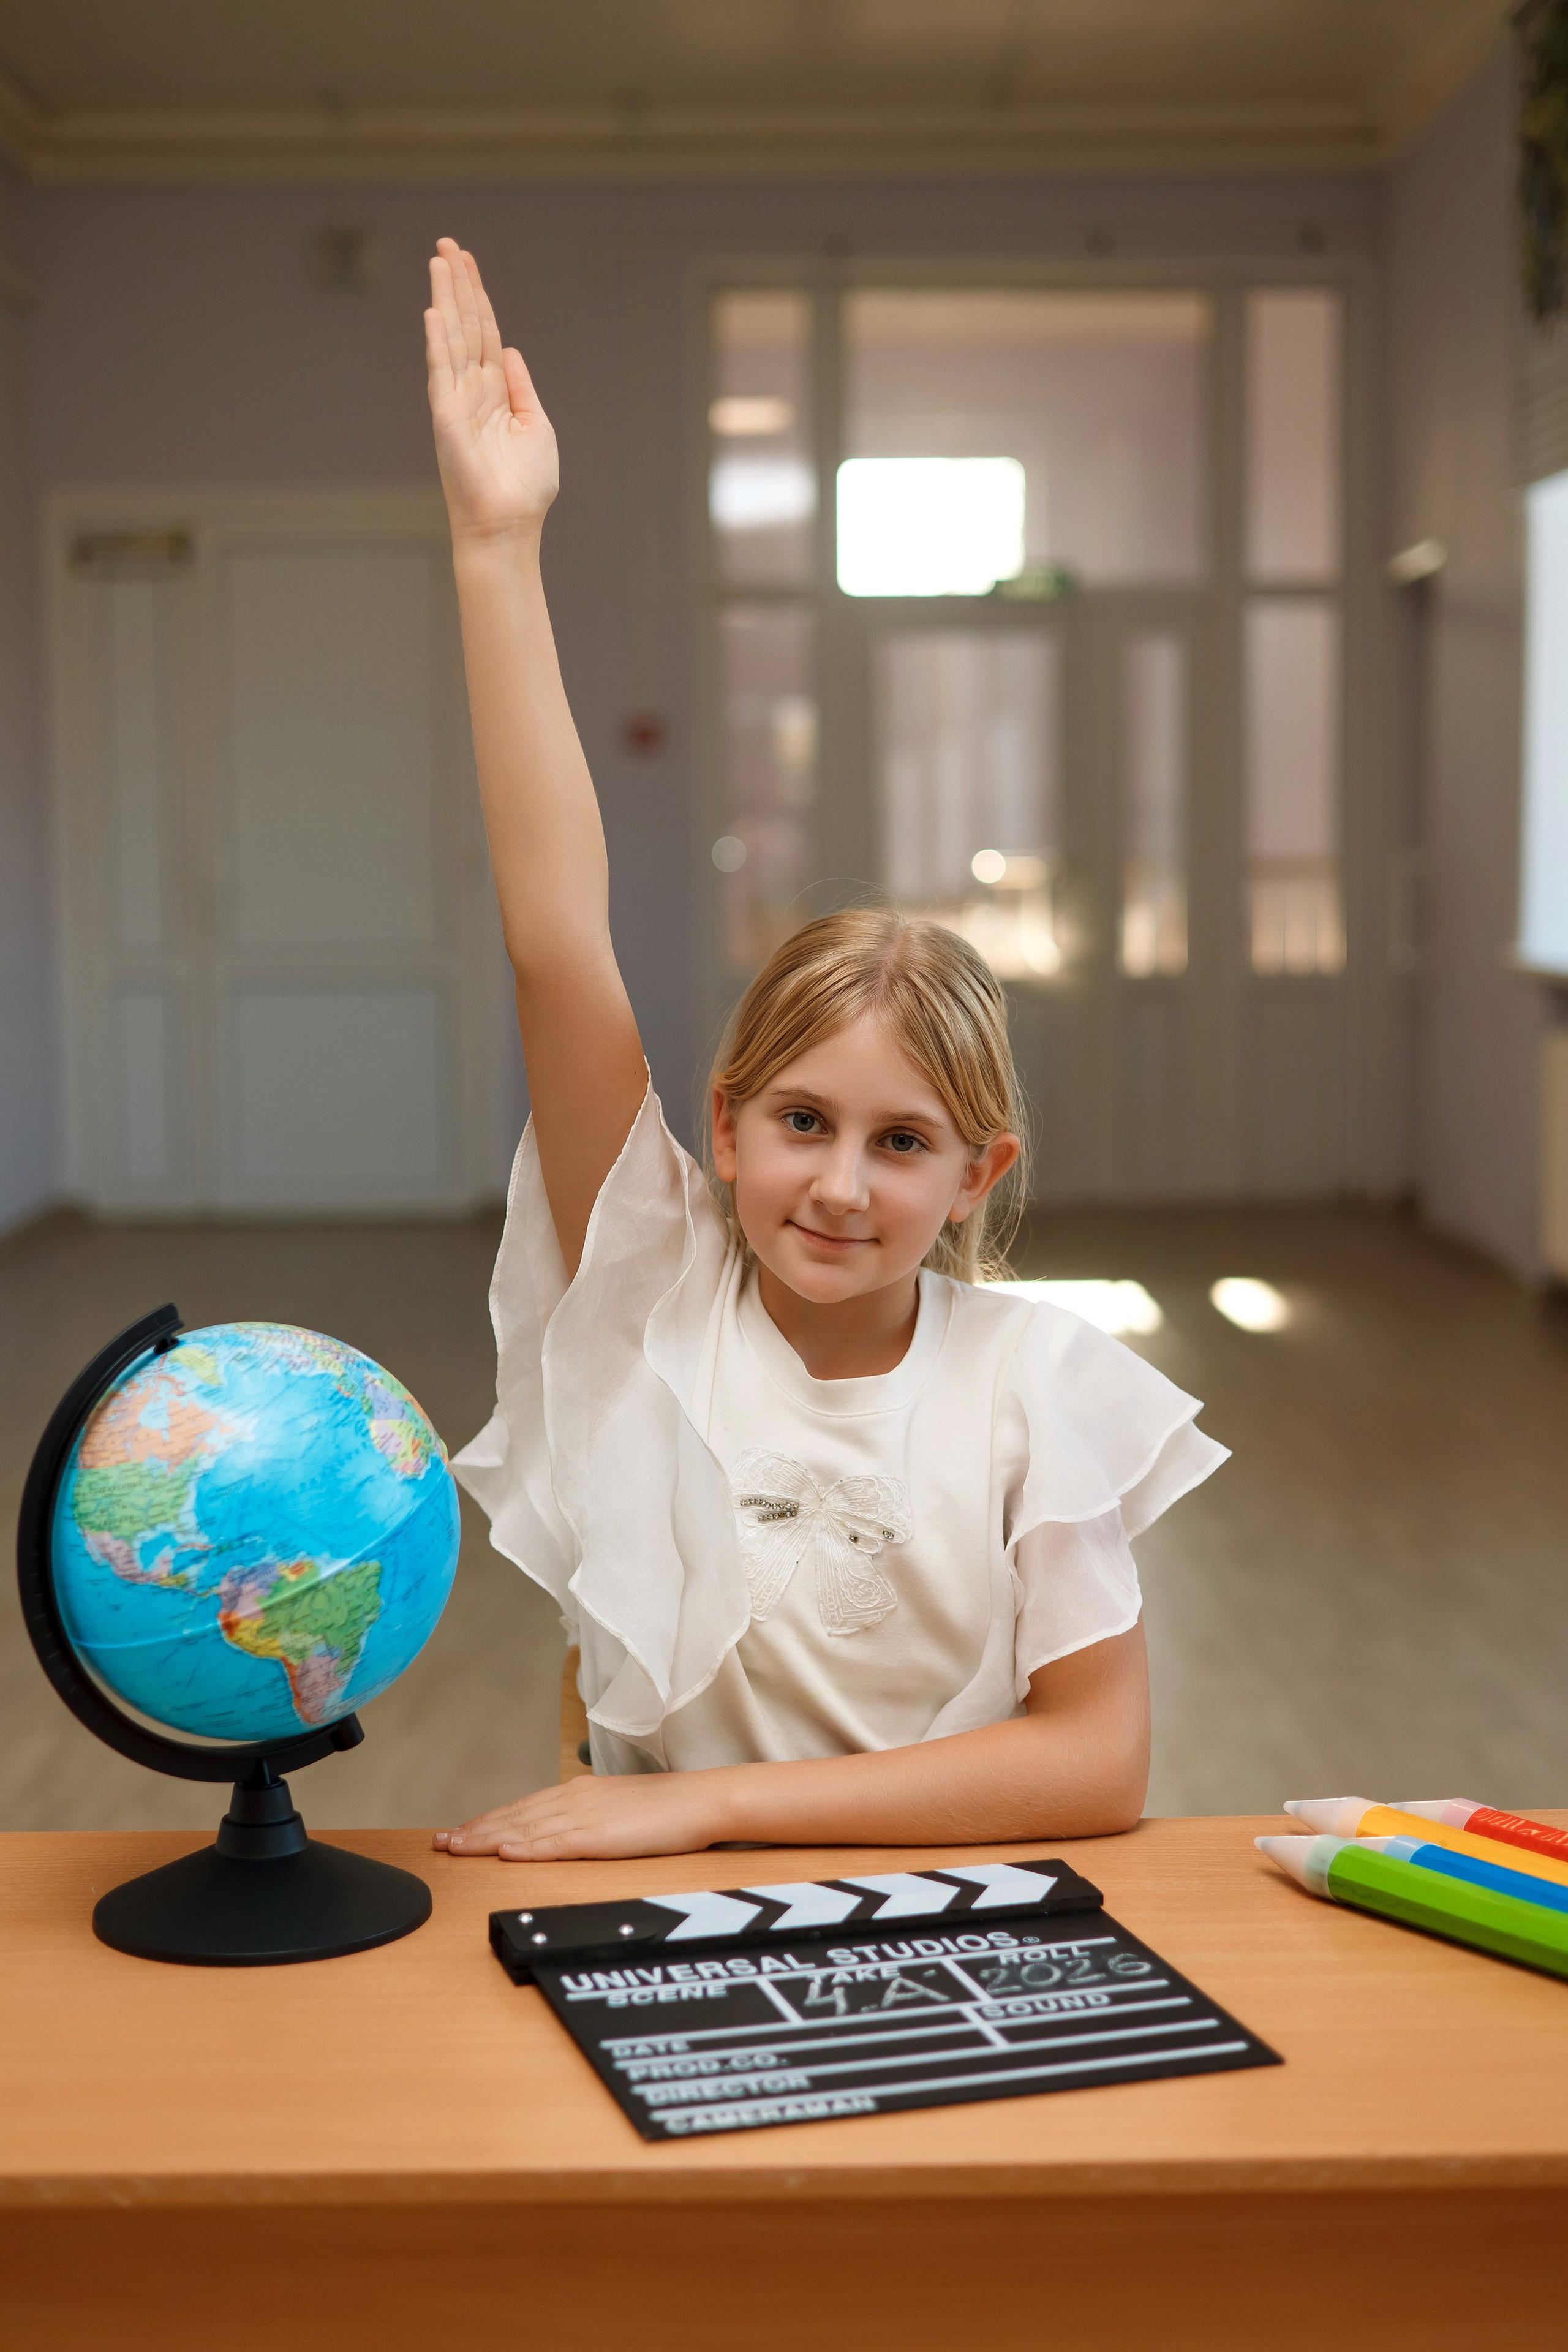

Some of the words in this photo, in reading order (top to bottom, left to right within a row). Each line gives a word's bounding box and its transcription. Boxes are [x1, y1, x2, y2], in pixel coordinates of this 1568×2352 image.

[998, 1945, 1091, 1965] ROLL
[560, 1953, 816, 1991] UNIVERSAL
[806, 1966, 901, 1986] TAKE
[979, 1953, 1152, 1994] 2026
[606, 1982, 728, 2007] SCENE
[981, 1994, 1110, 2018] SOUND
[612, 2040, 690, 2059] DATE
[644, 2074, 812, 2106] DIRECTOR
[664, 2095, 876, 2134] CAMERAMAN
